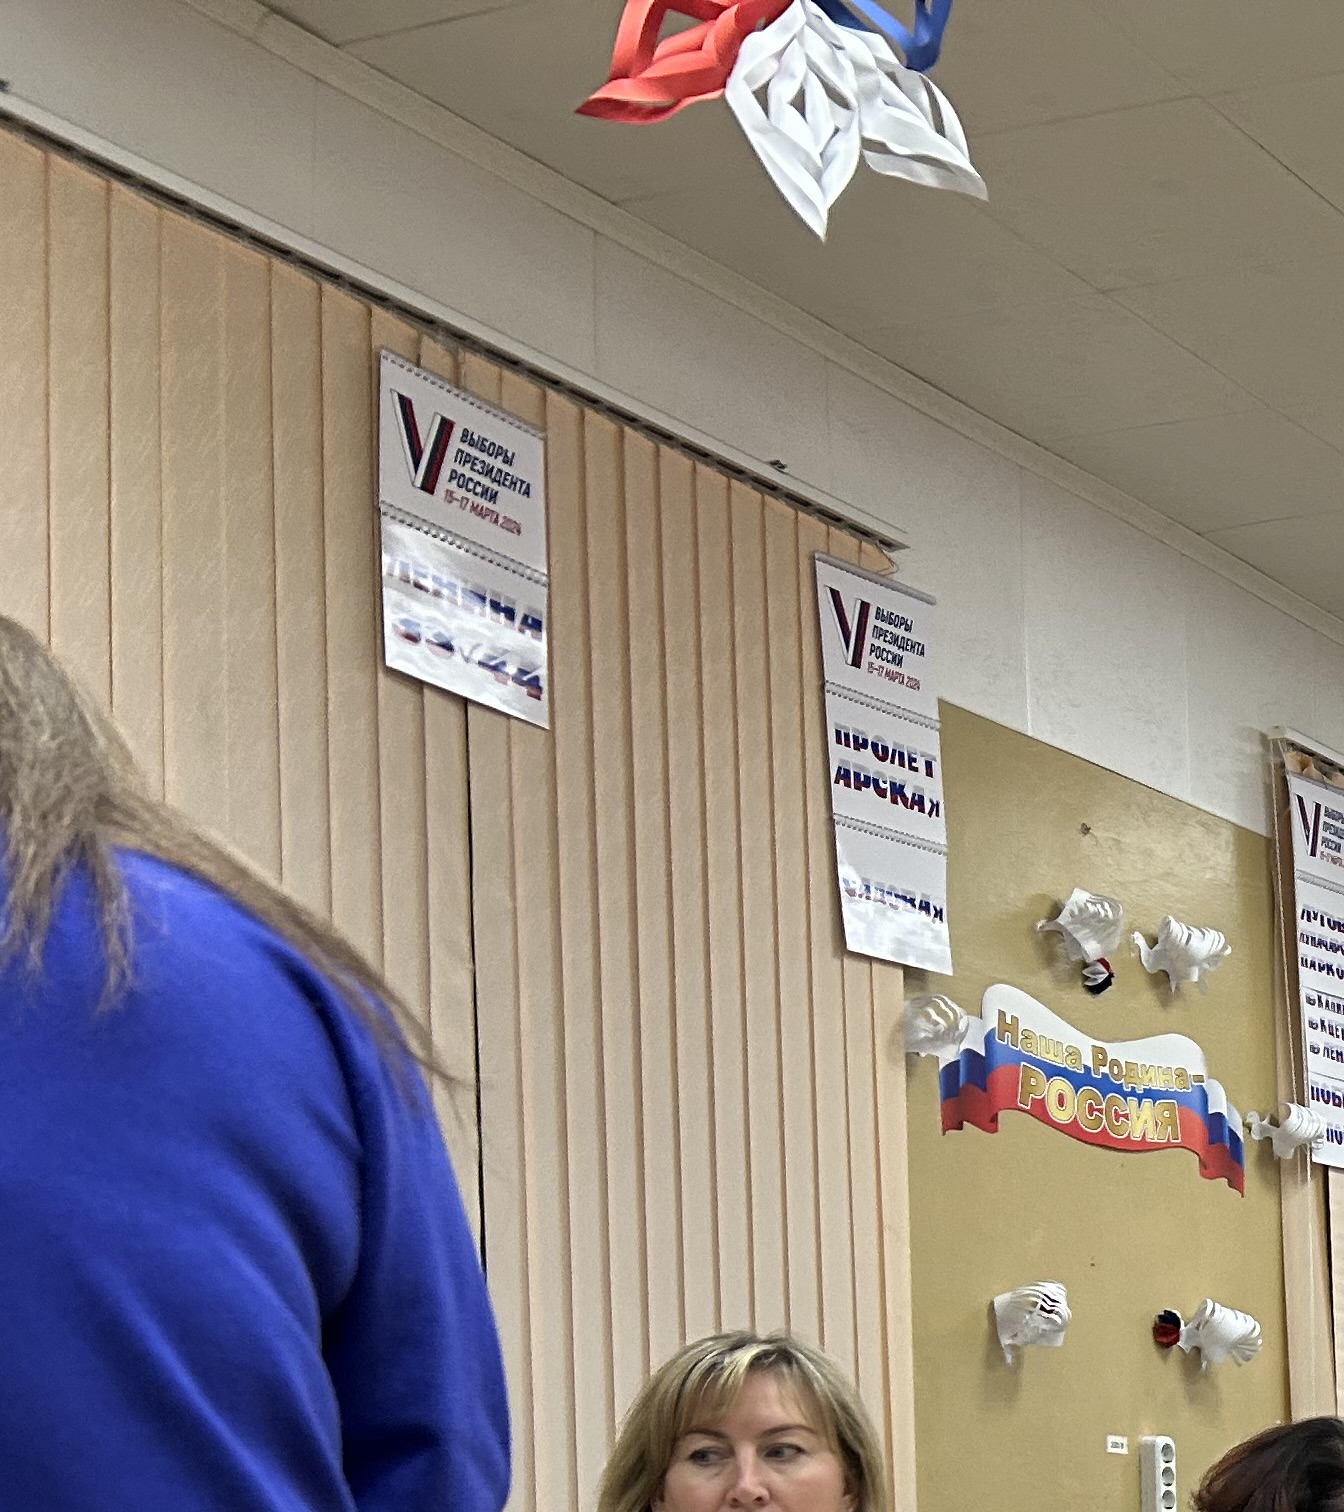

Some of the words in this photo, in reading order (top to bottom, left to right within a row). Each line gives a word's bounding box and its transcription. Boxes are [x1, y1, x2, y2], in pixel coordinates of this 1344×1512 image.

[460, 428, 516, 467] ВЫБОРЫ
[448, 469, 500, 505] РОССИИ
[454, 448, 532, 499] ПРЕЗИДЕНТА
[871, 625, 925, 657] ПРЕЗИДЕНТА
[874, 605, 914, 633] ВЫБОРЫ
[869, 643, 904, 668] РОССИИ
[834, 721, 937, 779] ПРОЛЕТ
[833, 758, 941, 819] АРСКАЯ
[996, 1008, 1083, 1071] Наша
[1017, 1061, 1181, 1142] РОССИЯ
